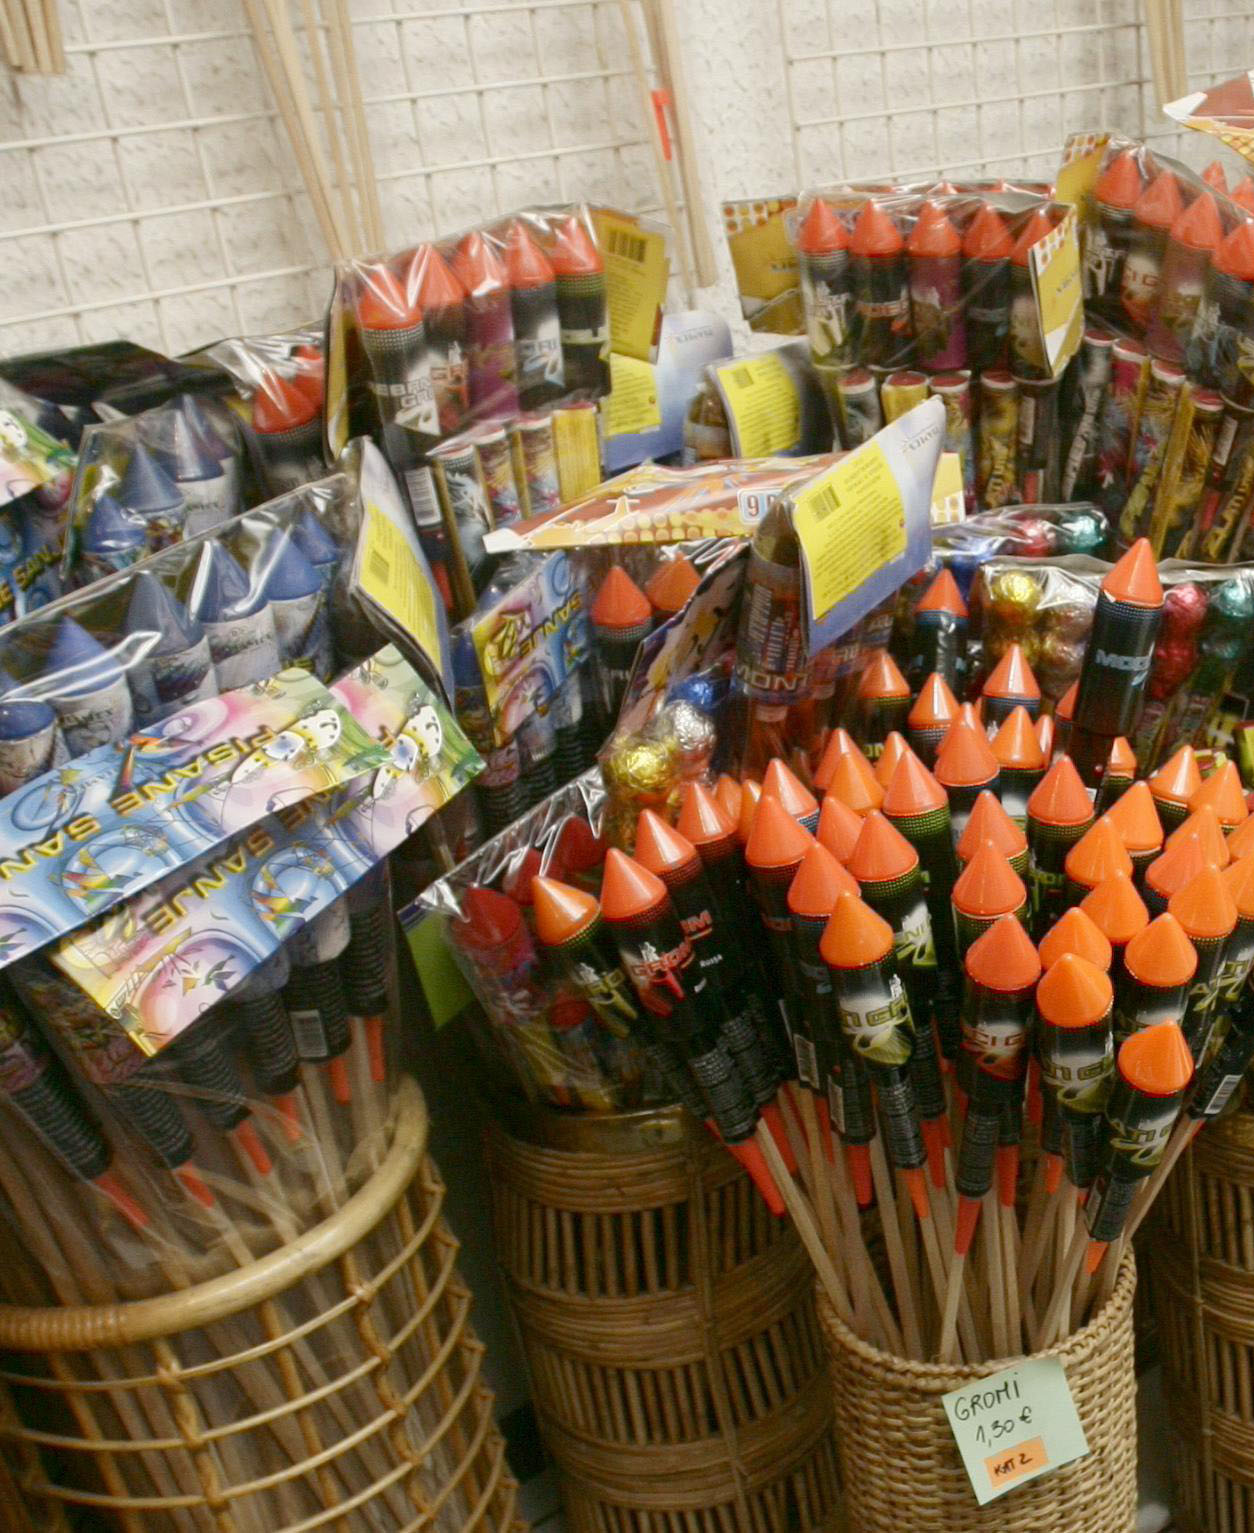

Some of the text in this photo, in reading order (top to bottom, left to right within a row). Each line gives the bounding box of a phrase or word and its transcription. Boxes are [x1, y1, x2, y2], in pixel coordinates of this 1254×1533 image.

[110, 724, 277, 817] PISANE
[143, 826, 276, 937] SANJE
[1018, 1452, 1034, 1466] 2
